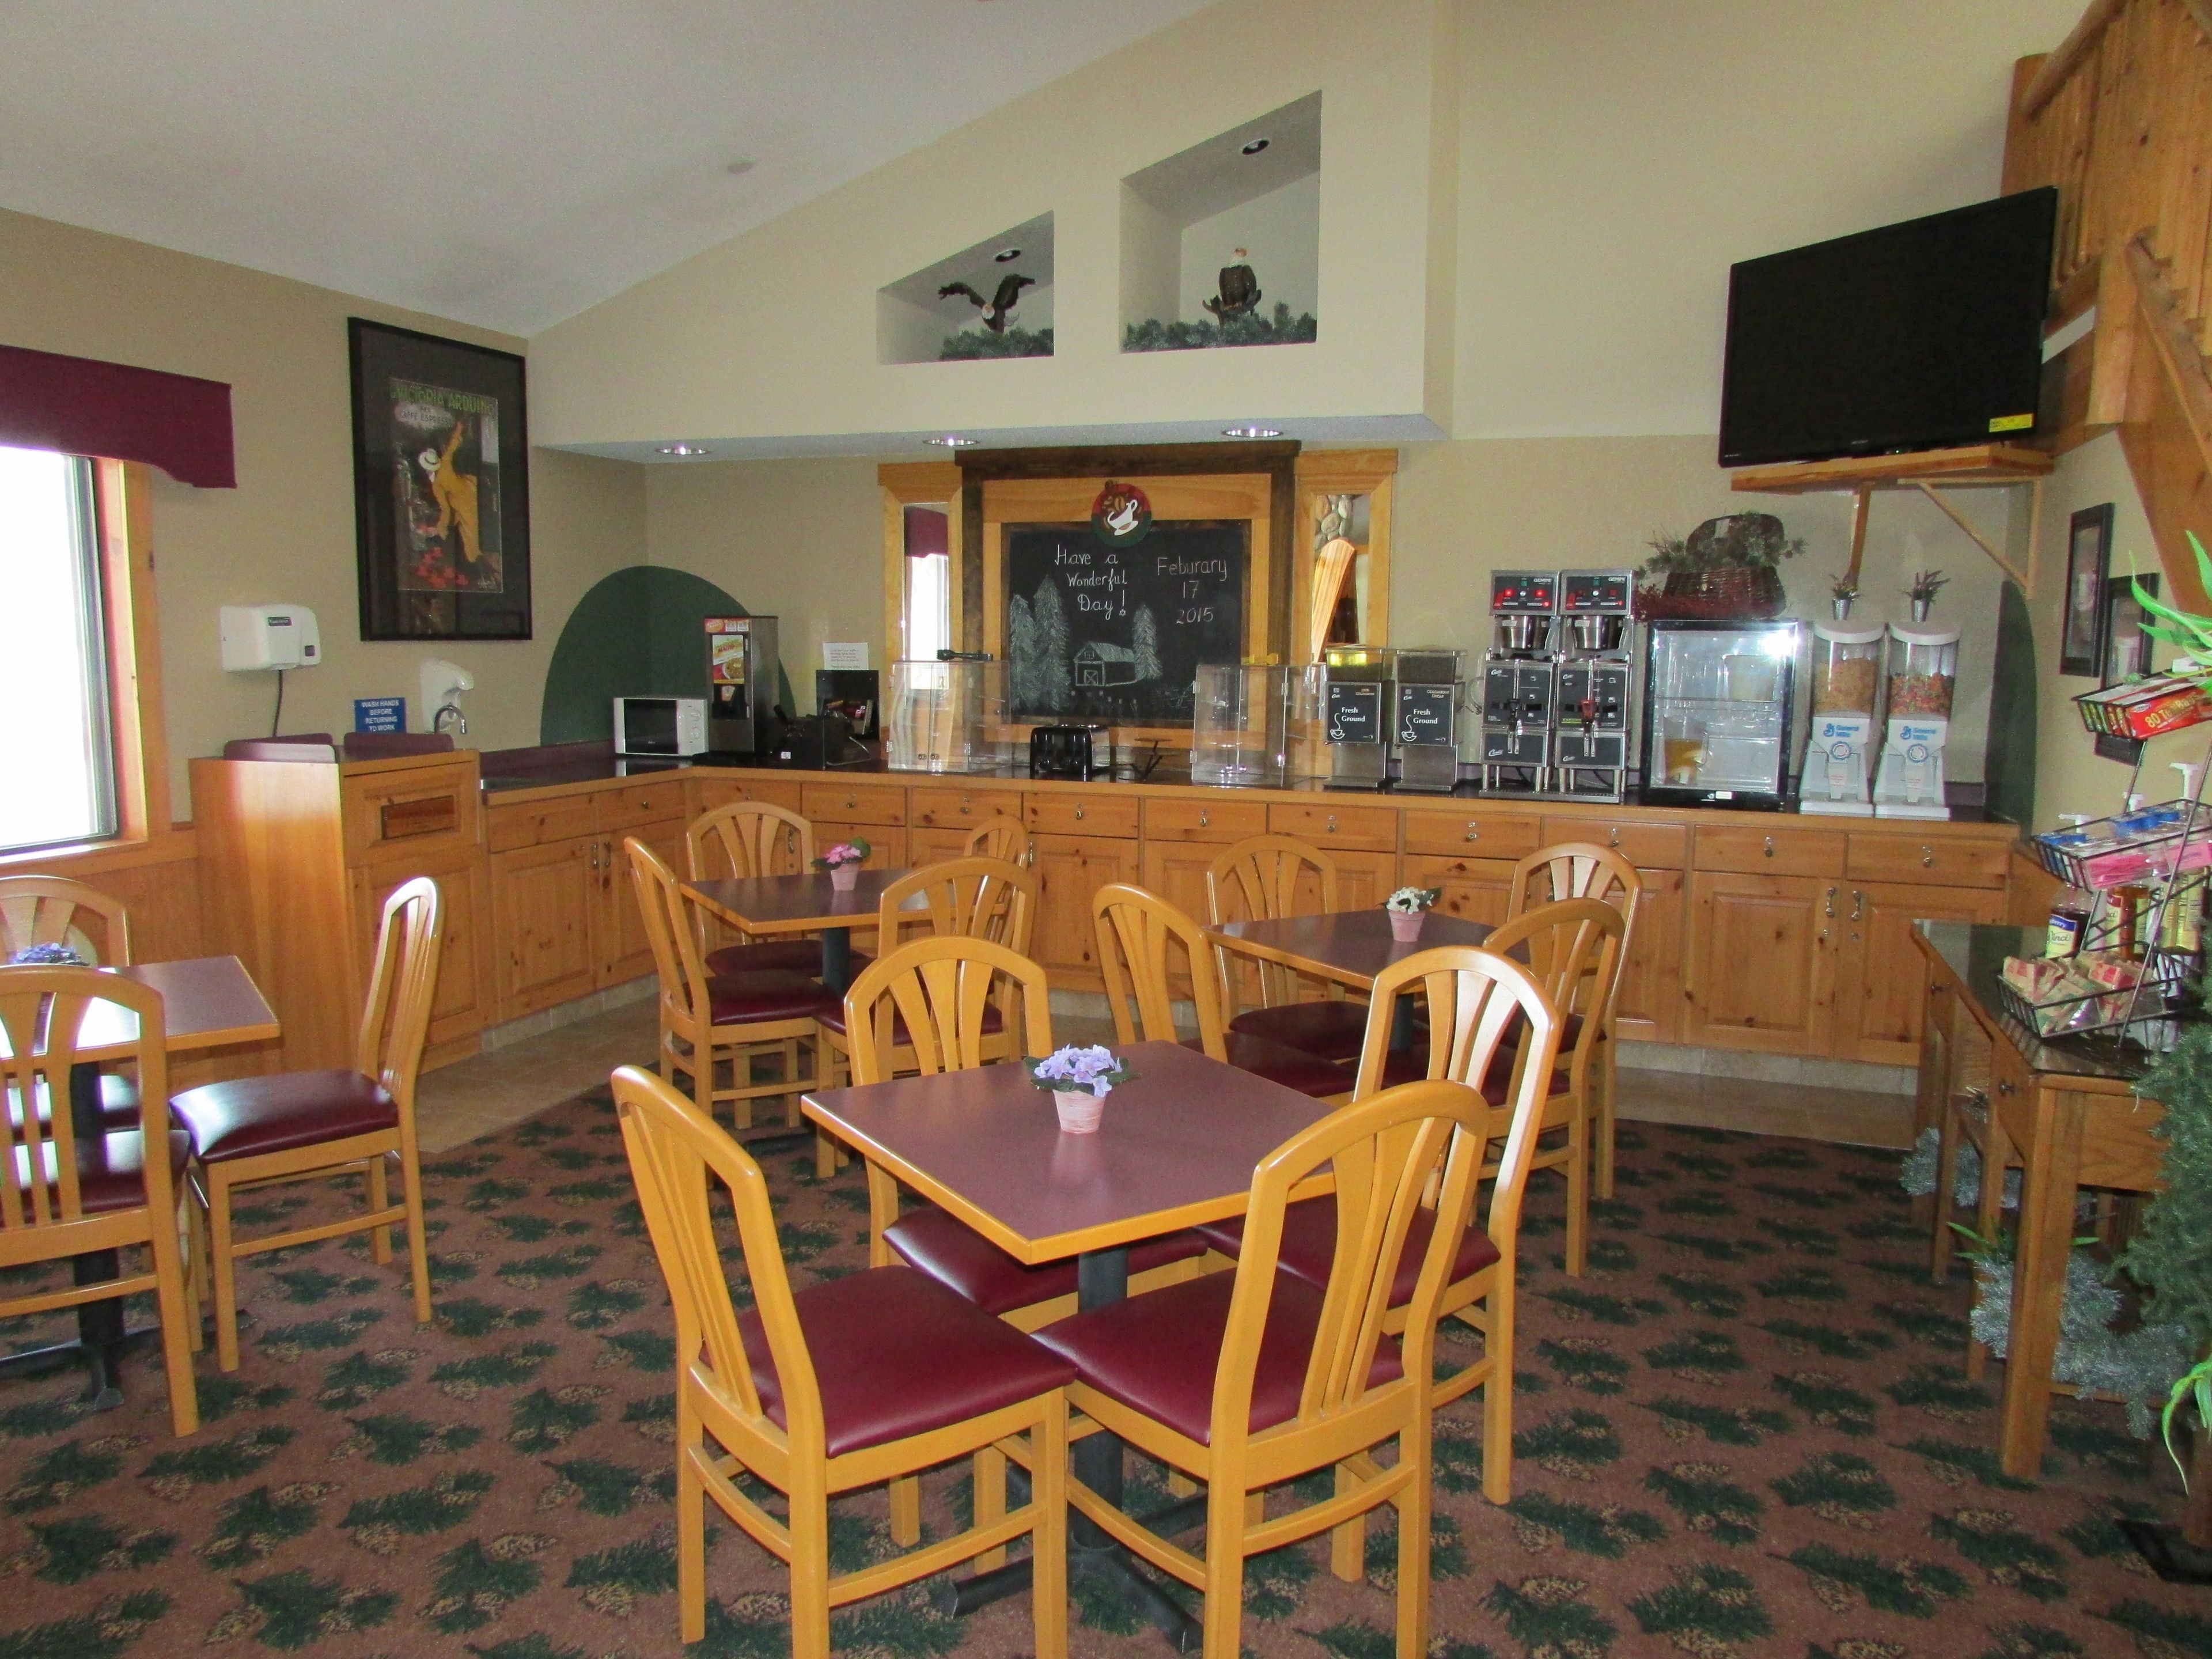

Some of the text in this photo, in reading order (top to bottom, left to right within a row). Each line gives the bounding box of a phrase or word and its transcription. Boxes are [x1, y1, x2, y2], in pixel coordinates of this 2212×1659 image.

[1055, 544, 1118, 565] Have a
[1157, 555, 1228, 582] Feburary
[1066, 568, 1127, 592] Wonderful
[1183, 580, 1199, 599] 17
[1176, 607, 1214, 624] 2015
[2145, 713, 2160, 728] 80
